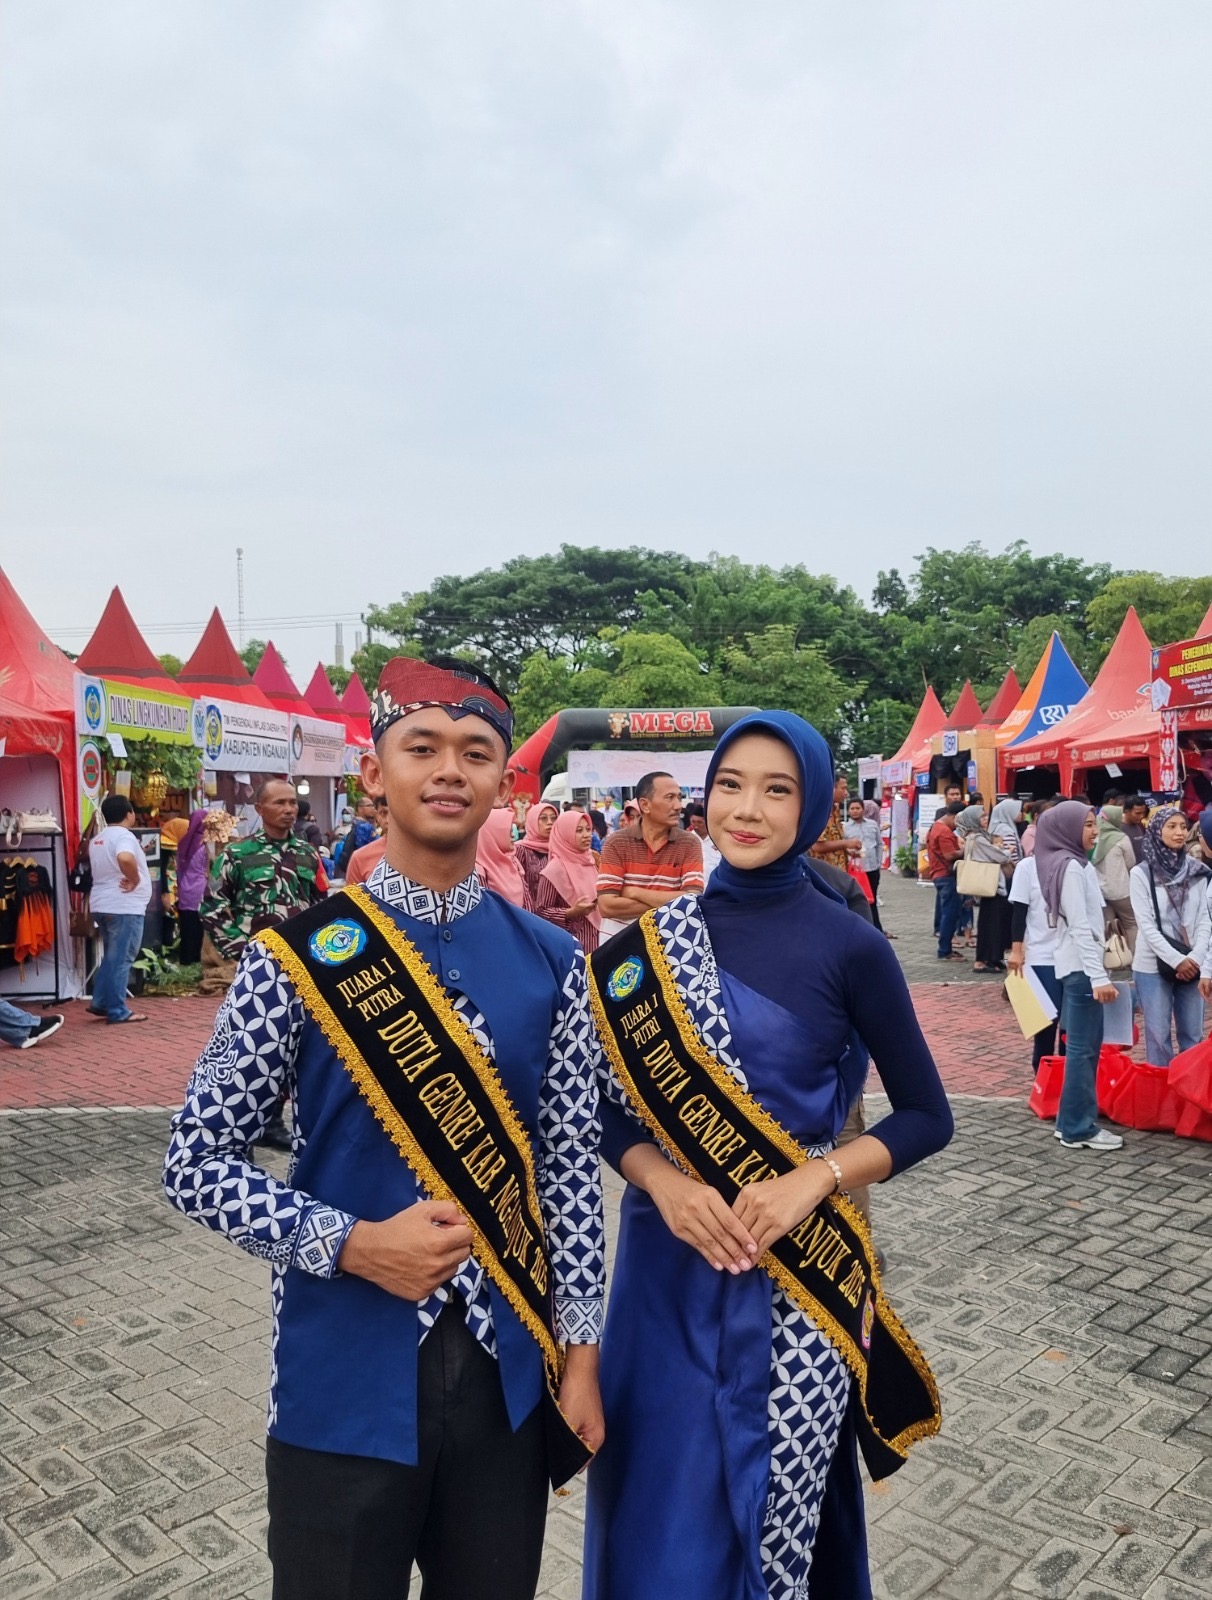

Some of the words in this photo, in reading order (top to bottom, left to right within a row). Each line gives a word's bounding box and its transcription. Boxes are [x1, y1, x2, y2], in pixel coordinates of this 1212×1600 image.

[110, 695, 132, 725] DINAS
[133, 698, 172, 730] LINGKUNGAN
[172, 706, 189, 733] HIDUP
[629, 711, 714, 733] MEGA
[223, 738, 261, 758] KABUPATEN
[262, 741, 288, 760] NGANJUK
[336, 964, 387, 1009] JUARA
[380, 957, 396, 975] I
[355, 983, 406, 1022] PUTRA
[620, 1000, 653, 1039] JUARA
[652, 993, 659, 1009] I
[632, 1016, 661, 1049] PUTRI
[642, 1039, 692, 1104] DUTA
[678, 1093, 747, 1166] GENRE
[377, 1010, 442, 1084] DUTA
[418, 1071, 485, 1151] GENRE
[489, 1173, 534, 1269] NGANJUK
[787, 1210, 852, 1281] ANJUK
[838, 1259, 866, 1309] 2025
